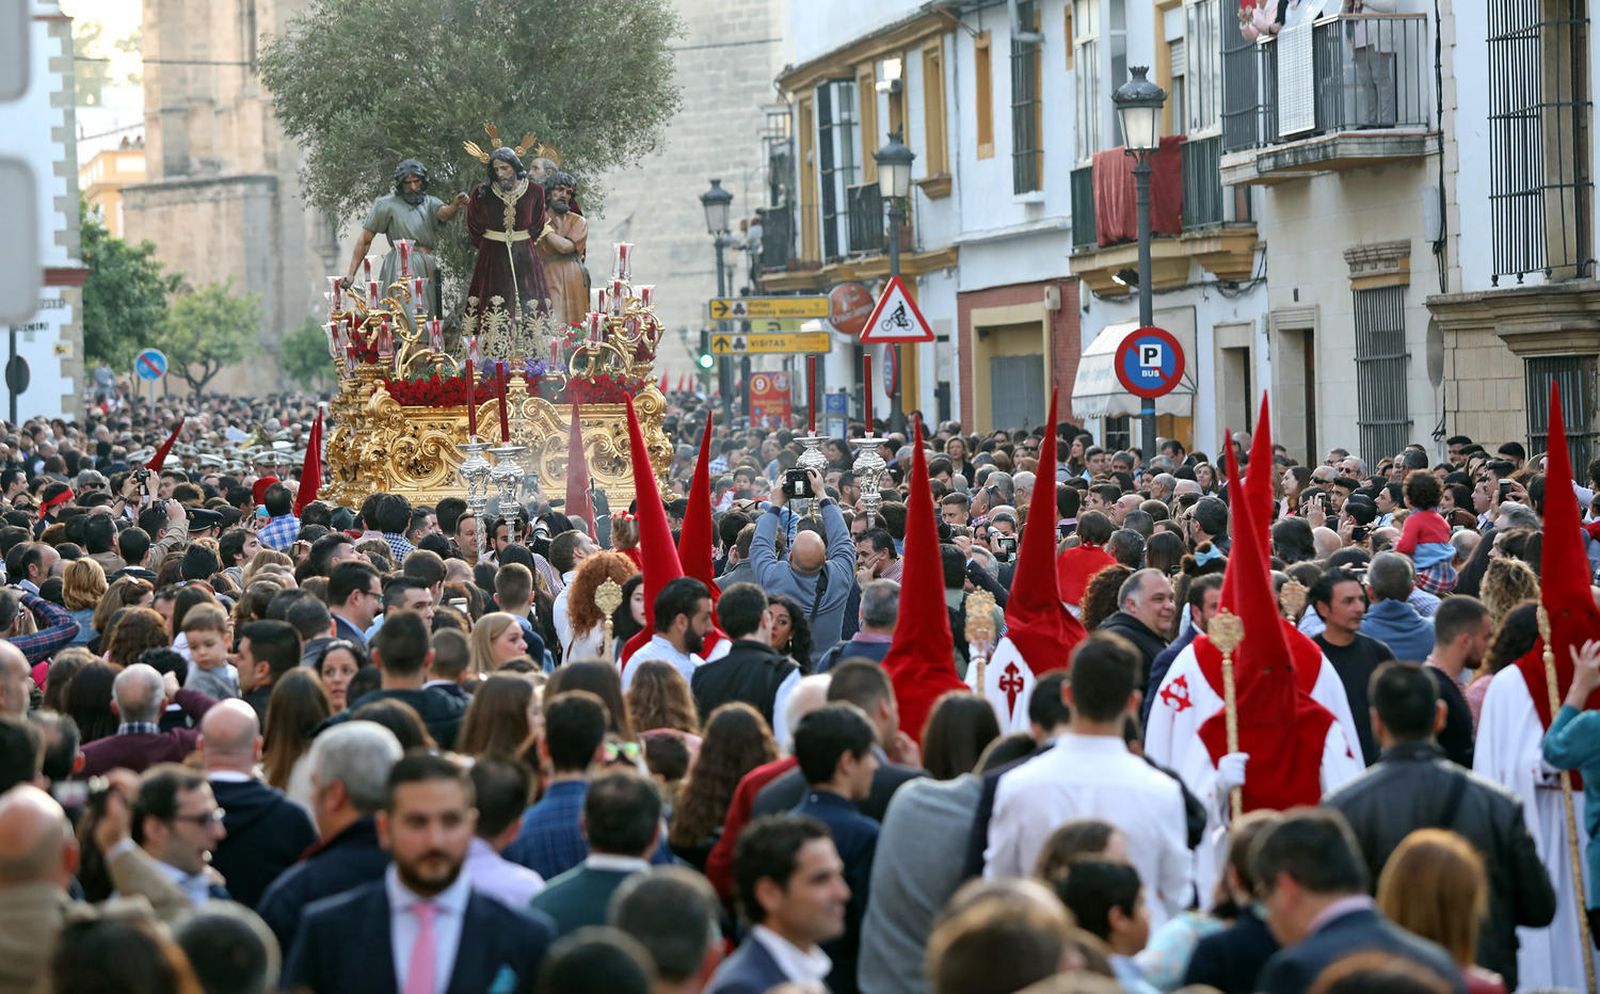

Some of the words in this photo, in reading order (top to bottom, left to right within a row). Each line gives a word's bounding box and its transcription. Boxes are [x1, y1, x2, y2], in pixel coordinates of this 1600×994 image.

[751, 339, 786, 348] VISITAS
[1144, 347, 1158, 364] P
[755, 378, 765, 391] 9
